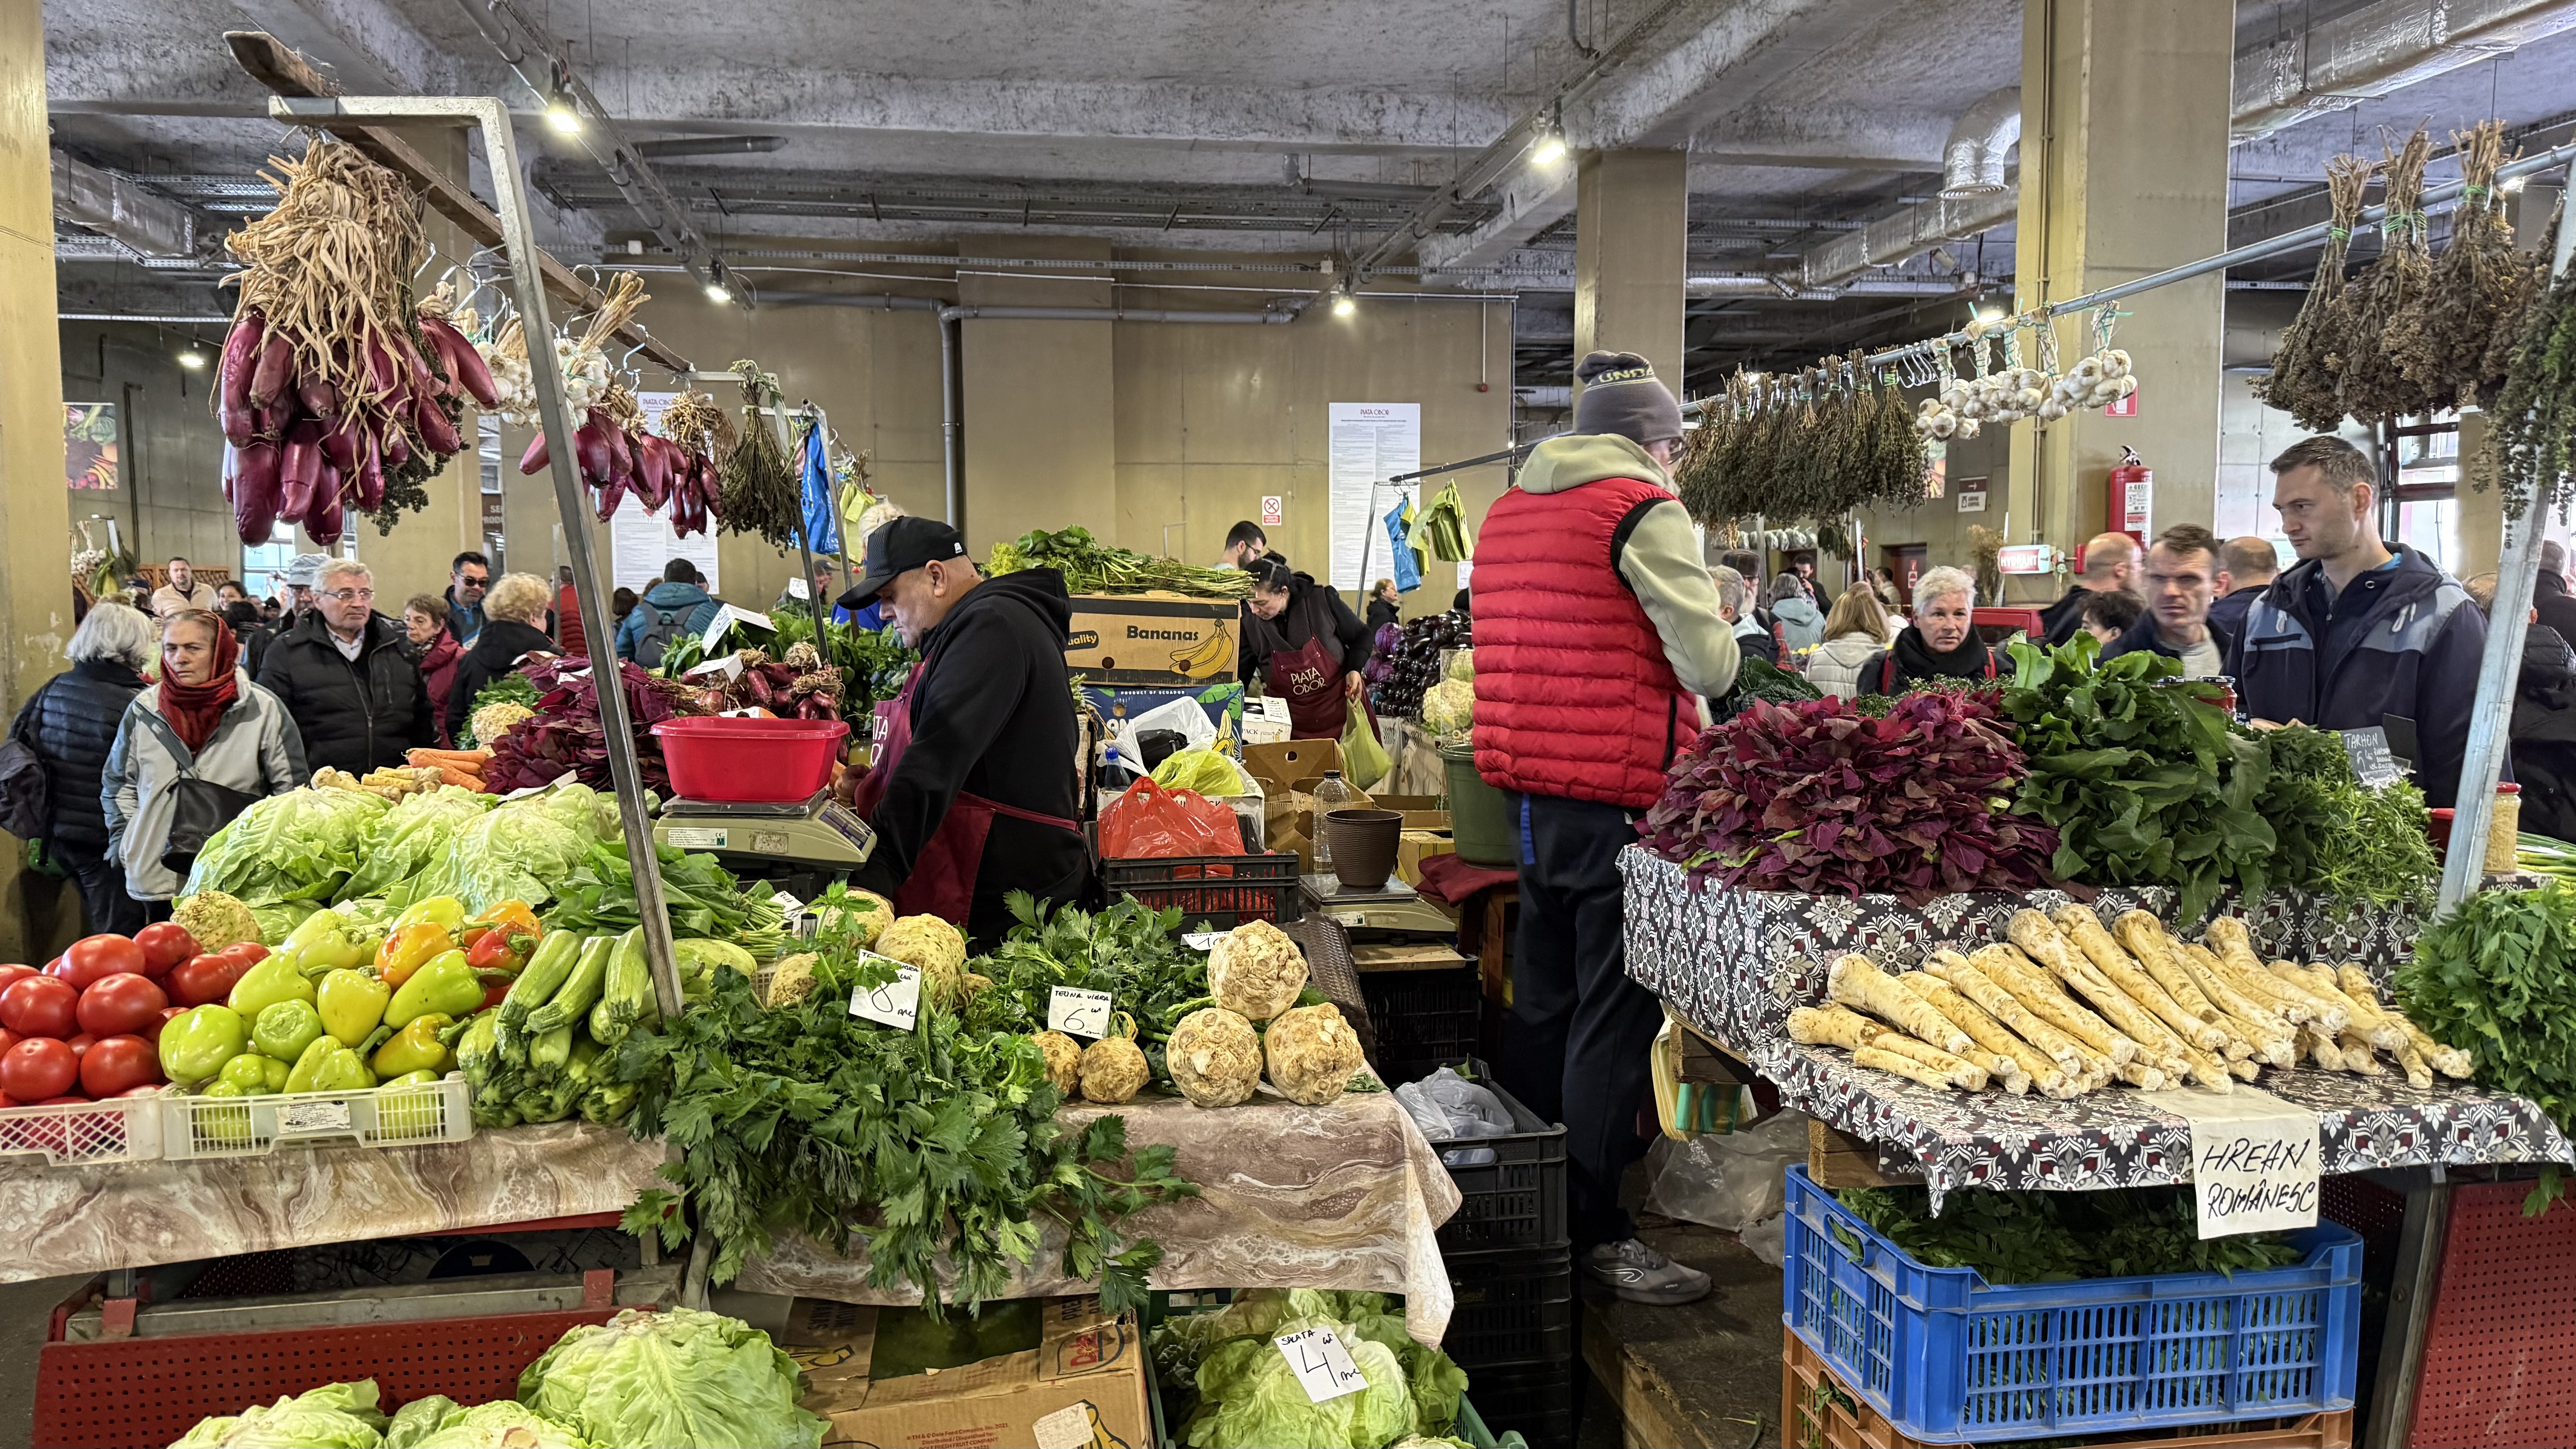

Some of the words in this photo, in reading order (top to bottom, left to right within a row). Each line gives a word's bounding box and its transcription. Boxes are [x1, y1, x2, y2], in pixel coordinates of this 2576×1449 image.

[2001, 555, 2037, 566] HYDRANT
[1068, 634, 1097, 646] uality
[1127, 625, 1199, 641] Bananas
[2344, 732, 2378, 749] TARHON
[871, 984, 893, 1013] 8
[1064, 1008, 1085, 1030] 6
[2200, 1138, 2310, 1174] HREAN
[2208, 1178, 2315, 1219] ROMÂNESC
[1300, 1344, 1338, 1387] 4
[956, 1432, 985, 1440] Dispatched
